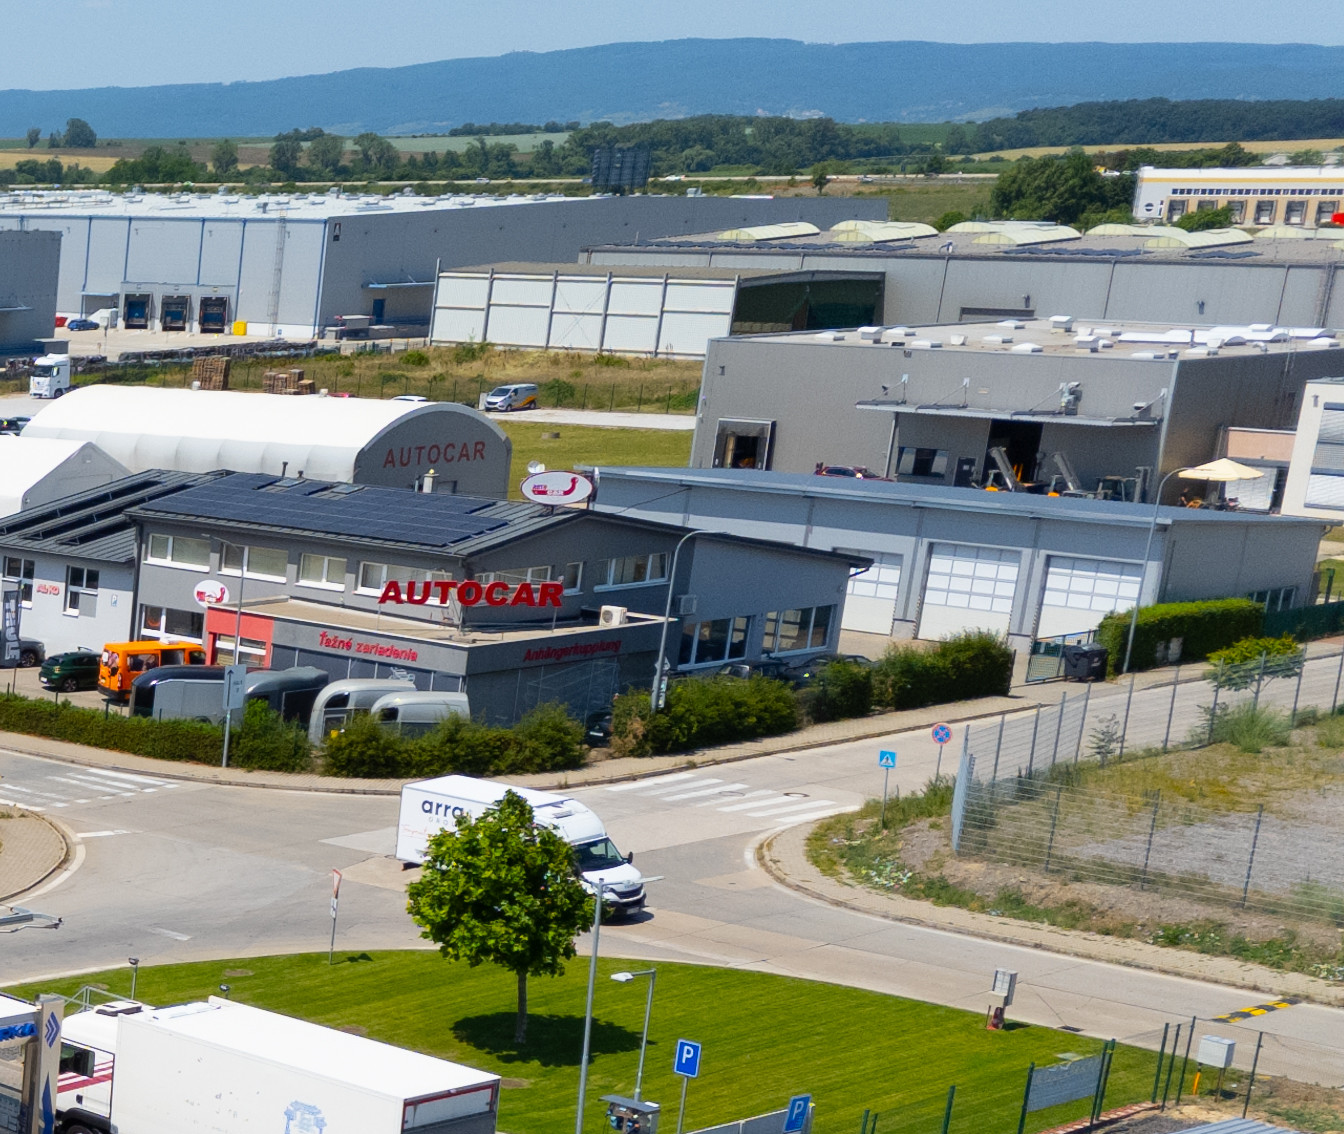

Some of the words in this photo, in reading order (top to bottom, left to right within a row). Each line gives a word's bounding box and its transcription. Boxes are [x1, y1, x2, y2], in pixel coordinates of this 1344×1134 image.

[383, 440, 486, 469] AUTOCAR
[378, 579, 564, 608] AUTOCAR
[355, 642, 418, 662] zariadenia
[682, 1045, 694, 1063] P
[793, 1101, 804, 1120] P
